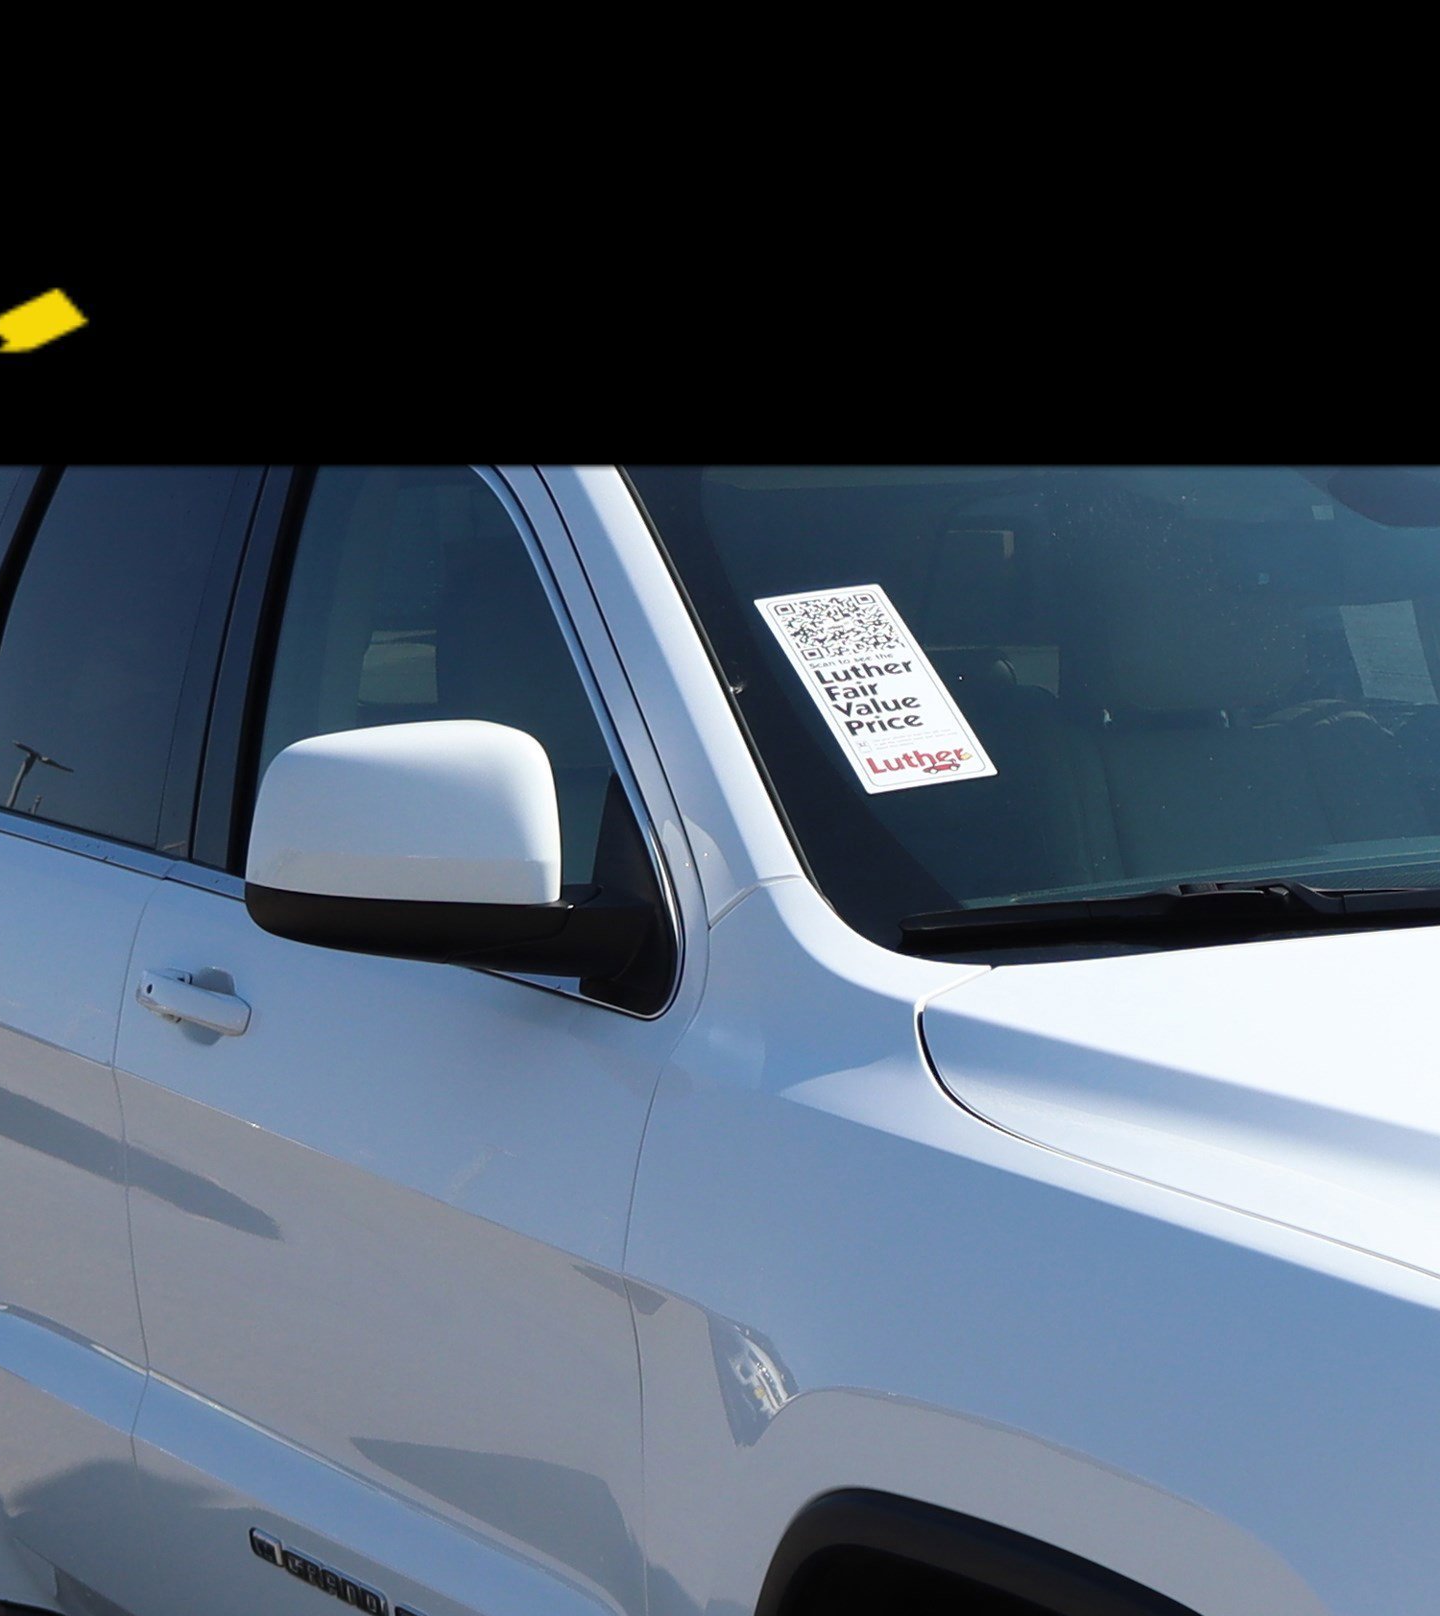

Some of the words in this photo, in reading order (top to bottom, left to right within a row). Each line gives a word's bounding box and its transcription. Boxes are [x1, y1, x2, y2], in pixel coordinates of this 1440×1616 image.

[839, 657, 851, 666] to
[875, 652, 894, 660] the
[814, 660, 912, 684] Luther
[824, 681, 878, 701] Fair
[832, 696, 921, 717] Value
[844, 714, 924, 736] Price
[866, 748, 965, 775] Luther
